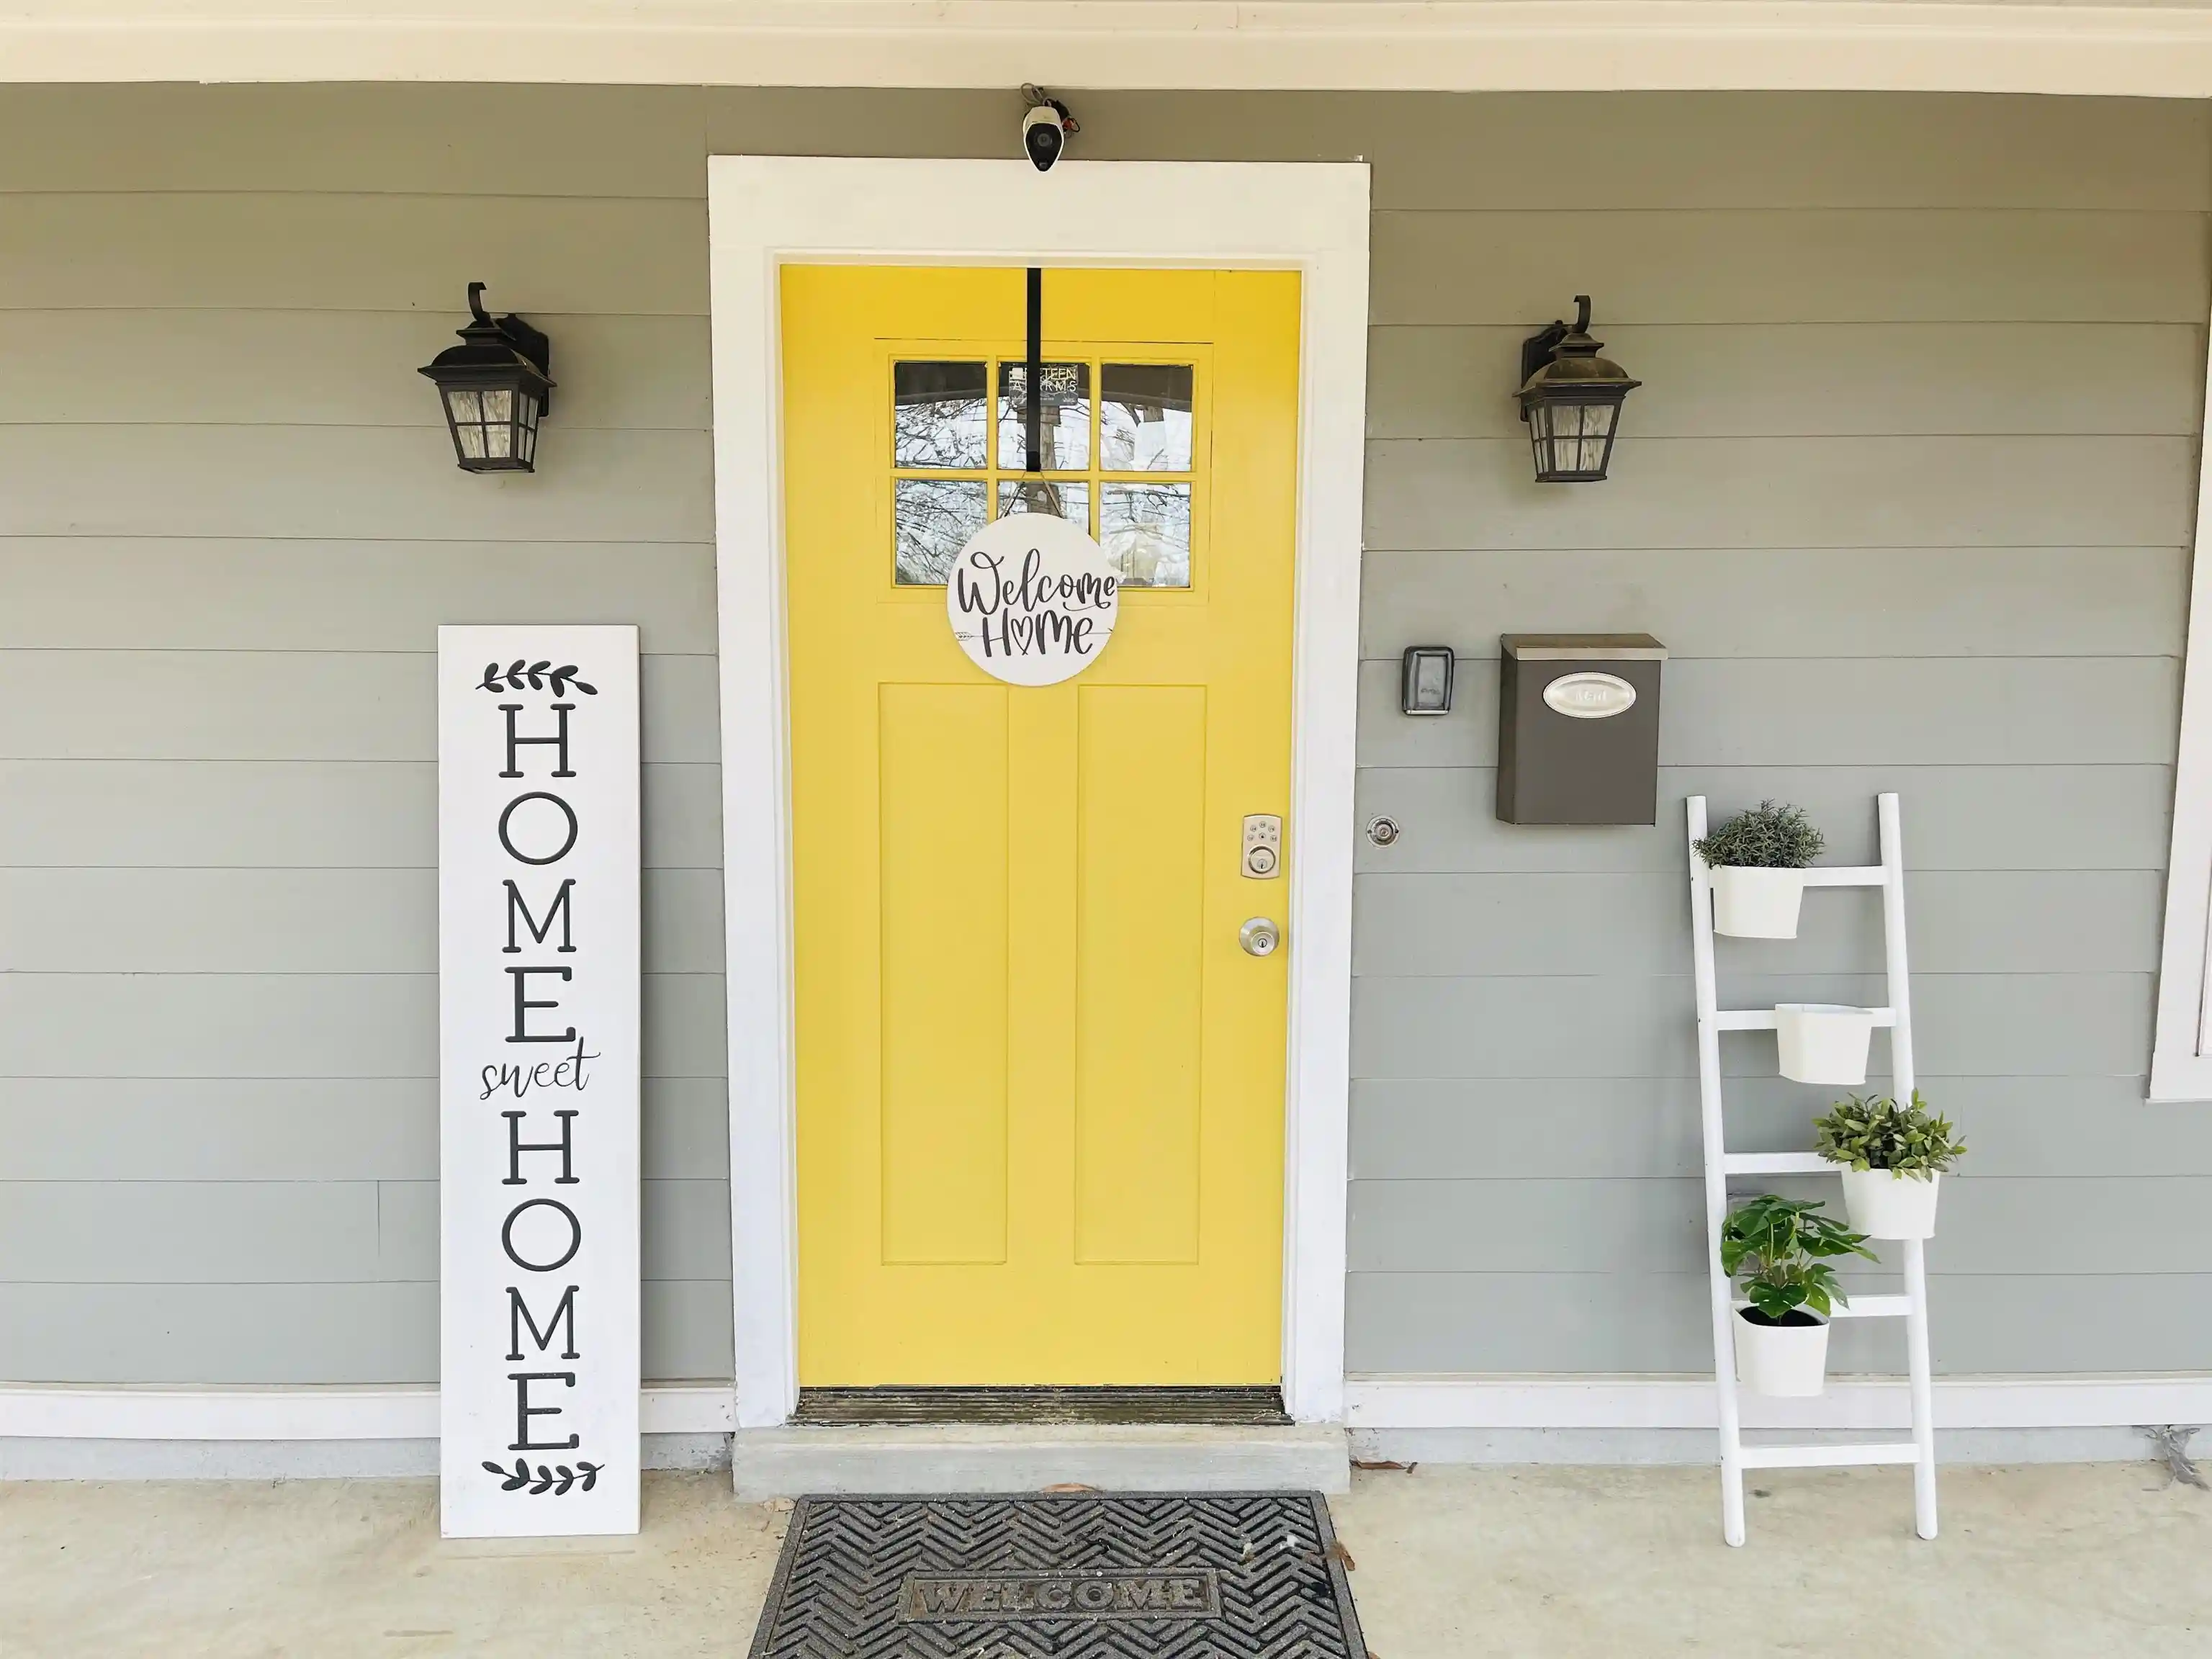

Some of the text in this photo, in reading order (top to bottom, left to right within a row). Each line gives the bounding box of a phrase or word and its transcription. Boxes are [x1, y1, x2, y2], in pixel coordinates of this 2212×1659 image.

[958, 548, 1115, 615] Welcome
[498, 703, 578, 1043] HOME
[480, 1036, 601, 1100] sweet
[500, 1109, 581, 1451] HOME
[917, 1578, 1203, 1614] WELCOME
